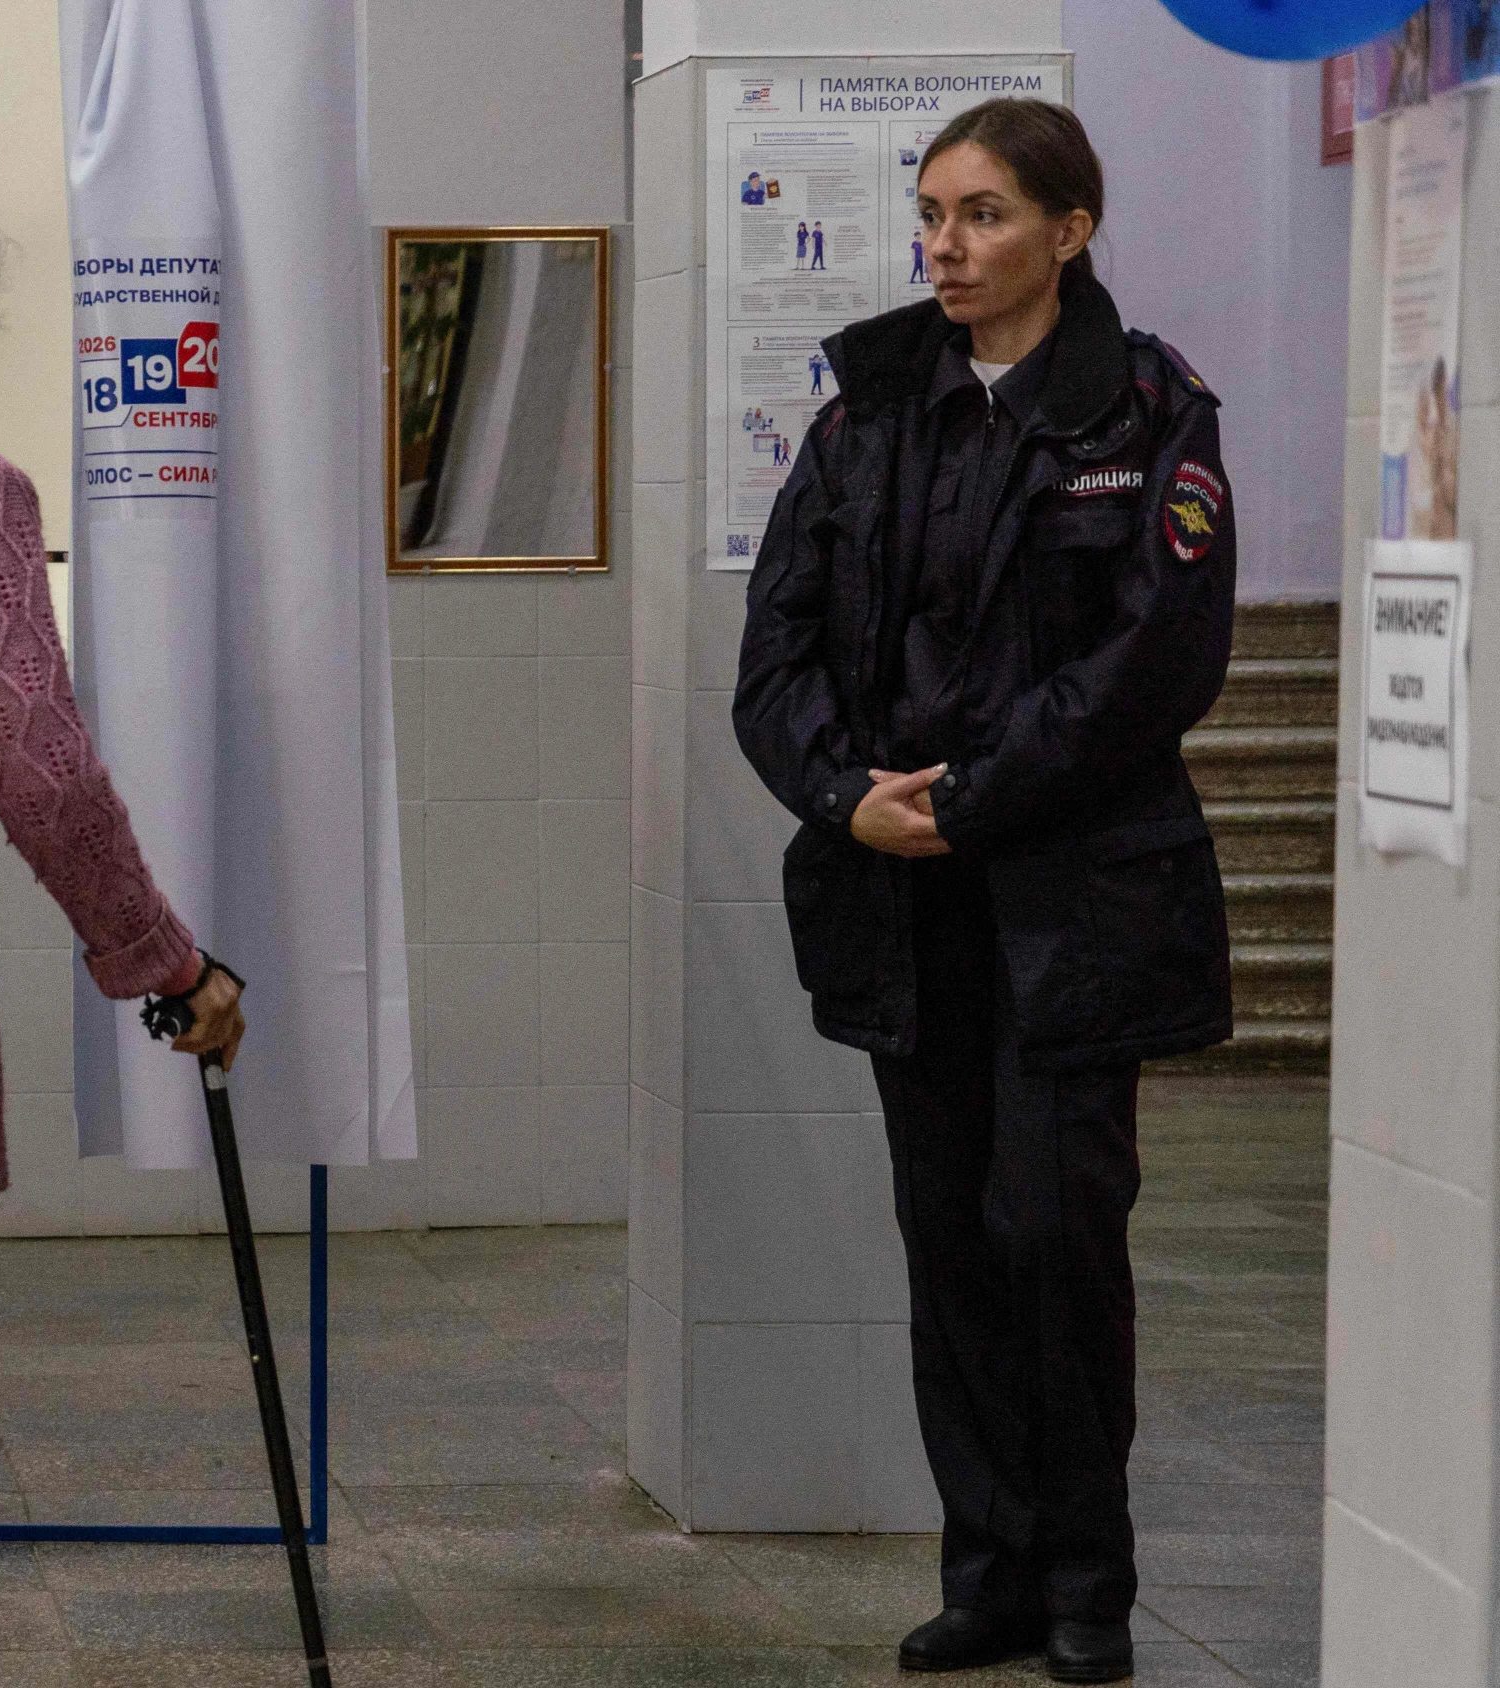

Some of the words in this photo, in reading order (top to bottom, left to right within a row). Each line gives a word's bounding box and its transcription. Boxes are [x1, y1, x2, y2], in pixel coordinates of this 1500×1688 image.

[819, 77, 908, 93] ПАМЯТКА
[914, 75, 1042, 92] ВОЛОНТЕРАМ
[819, 97, 845, 112] НА
[851, 96, 940, 112] ВЫБОРАХ
[915, 130, 923, 142] 2
[139, 257, 221, 276] ДЕПУТА
[78, 336, 116, 355] 2026
[753, 336, 760, 348] 3
[183, 336, 220, 374] 20
[127, 354, 173, 391] 19
[83, 376, 118, 414] 18
[85, 466, 132, 486] ОЛОС
[158, 465, 210, 484] СИЛА
[1180, 462, 1222, 496] ПОЛИЦИЯ
[1176, 481, 1218, 514] РОССИЯ
